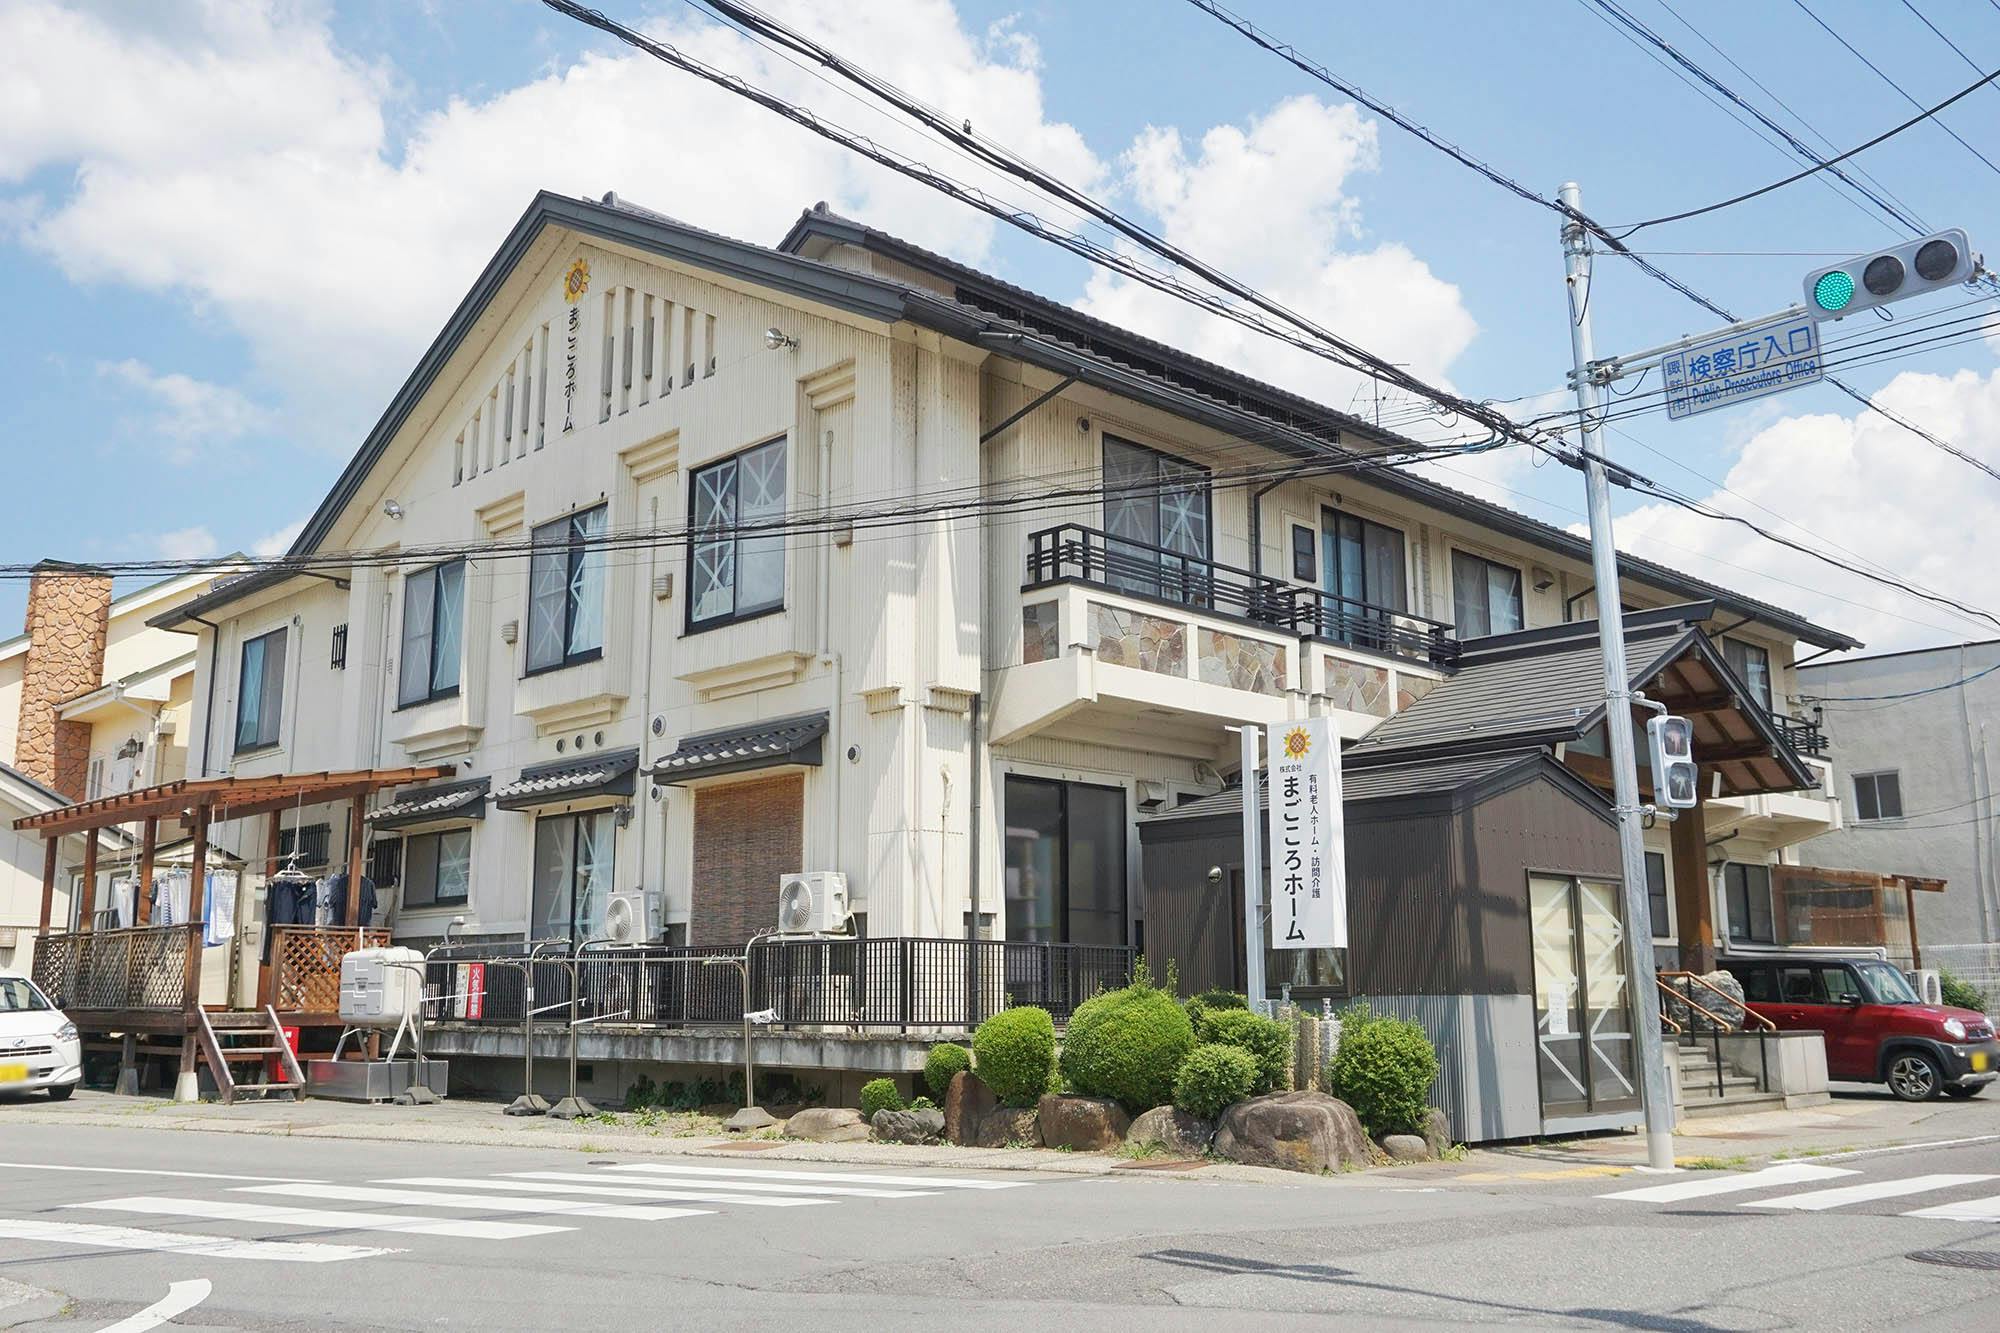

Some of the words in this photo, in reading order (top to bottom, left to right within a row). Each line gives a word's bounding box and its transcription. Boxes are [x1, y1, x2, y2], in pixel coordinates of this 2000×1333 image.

[562, 307, 581, 433] まごころホーム
[1689, 326, 1812, 382] 検察庁入口
[1692, 384, 1722, 405] Public
[1724, 367, 1782, 398] Prosecutors
[1785, 359, 1816, 381] Office
[1279, 764, 1302, 773] 株式会社
[1283, 775, 1306, 941] まごころホーム
[1309, 774, 1321, 898] 有料老人ホーム・訪問介護
